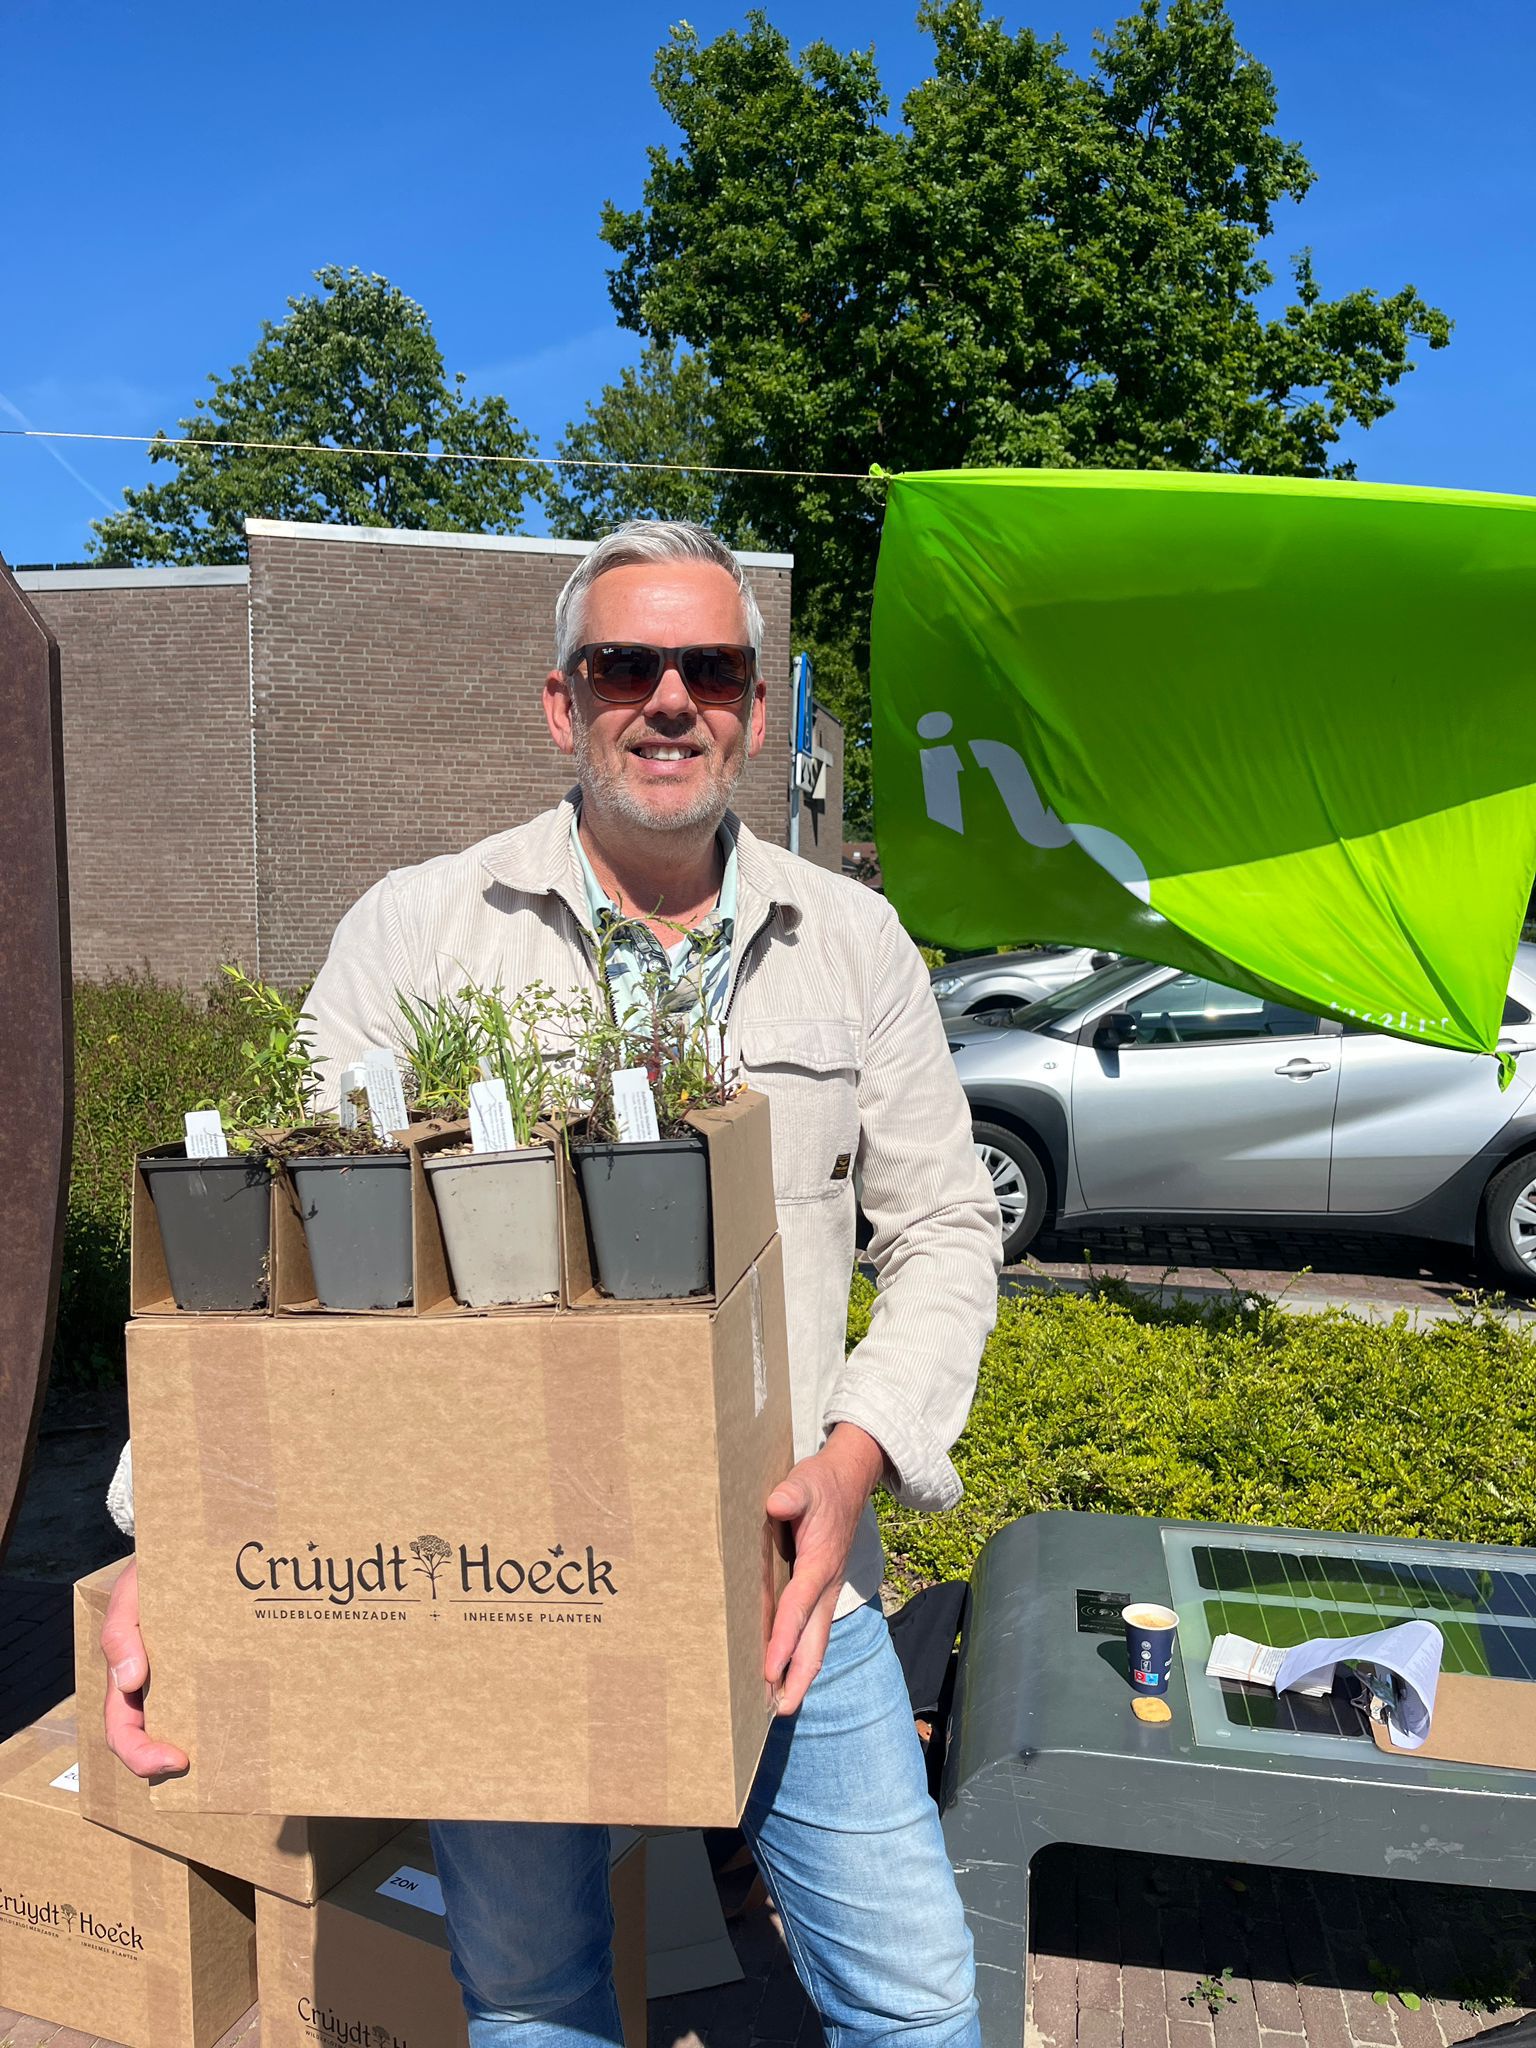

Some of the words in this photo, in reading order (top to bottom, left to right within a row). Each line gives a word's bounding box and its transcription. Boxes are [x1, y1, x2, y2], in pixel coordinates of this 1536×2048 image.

[458, 1543, 618, 1595] Hoeck
[254, 1609, 407, 1621] WILDEBLOEMENZADEN
[464, 1612, 533, 1622] INHEEMSE
[540, 1613, 602, 1623] PLANTEN
[390, 1875, 419, 1891] ZON
[0, 1893, 60, 1925] ruydt
[80, 1911, 144, 1950] Hoeck
